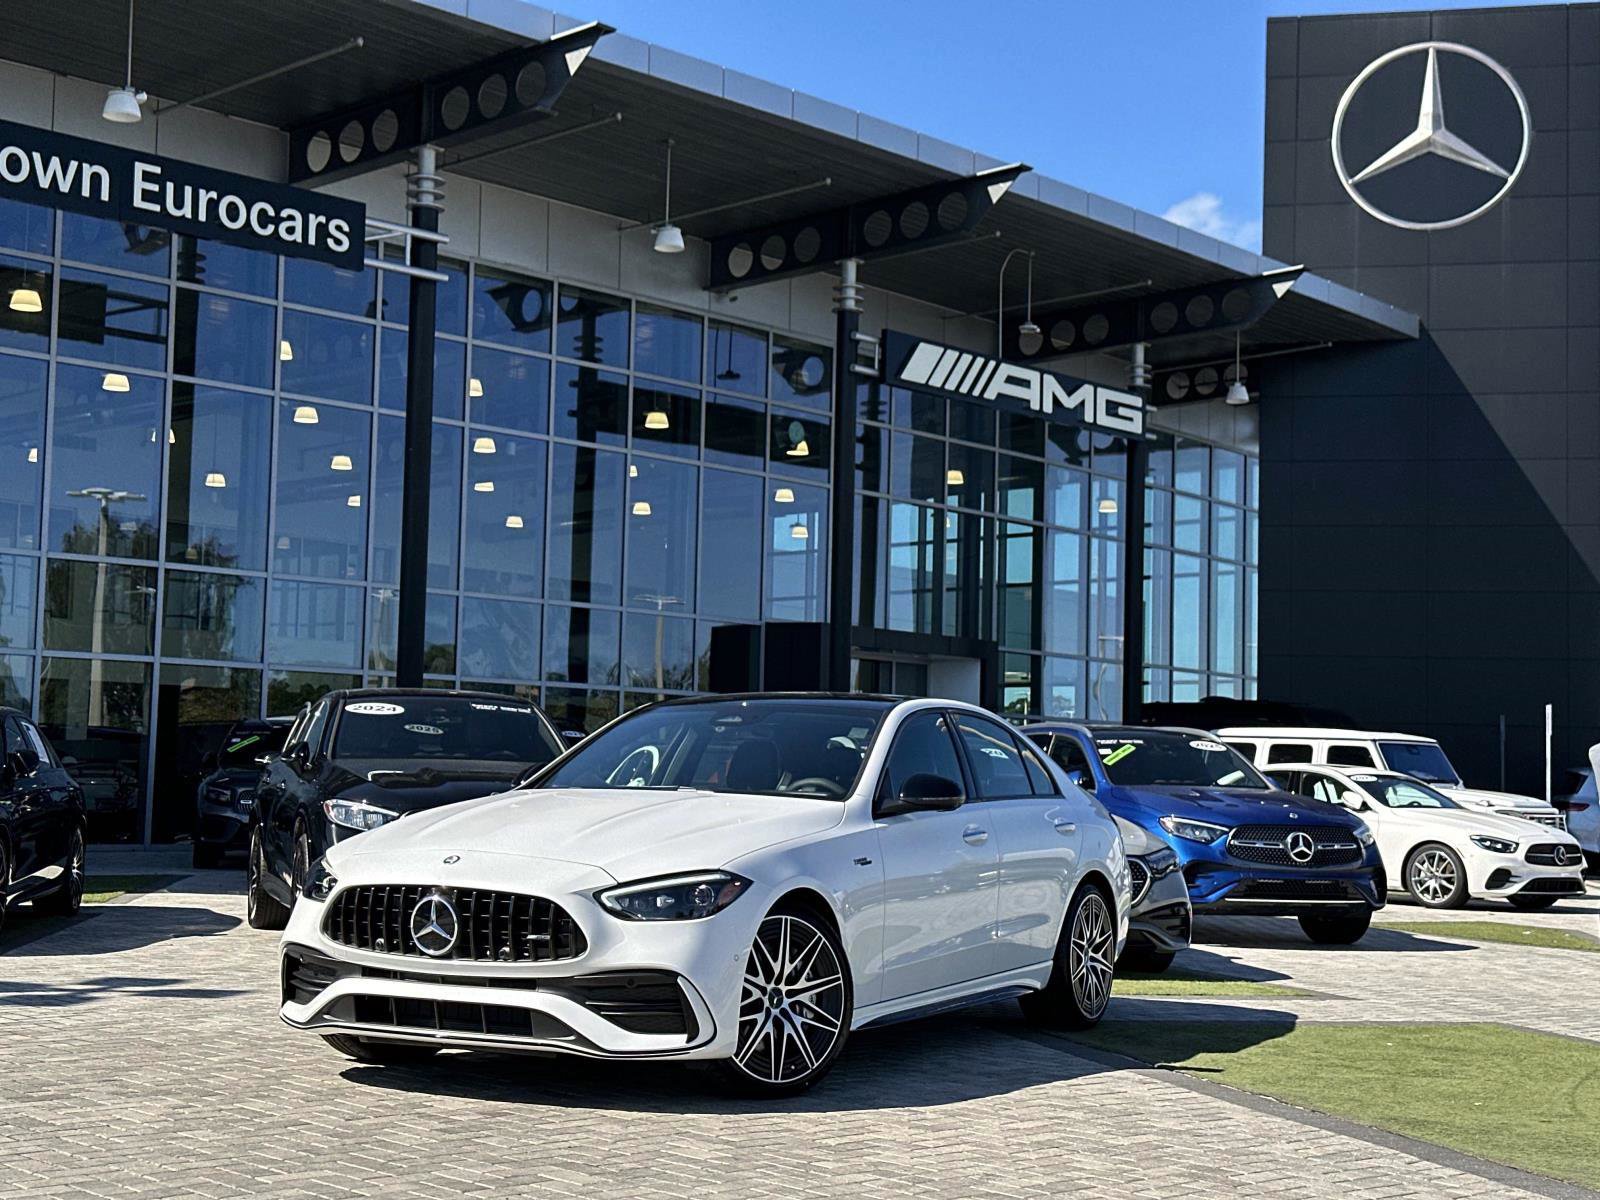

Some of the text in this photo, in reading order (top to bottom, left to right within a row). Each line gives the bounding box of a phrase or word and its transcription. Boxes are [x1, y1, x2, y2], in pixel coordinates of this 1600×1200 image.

[0, 146, 350, 252] own Eurocars
[984, 362, 1144, 434] AMG
[353, 704, 397, 713] 2024
